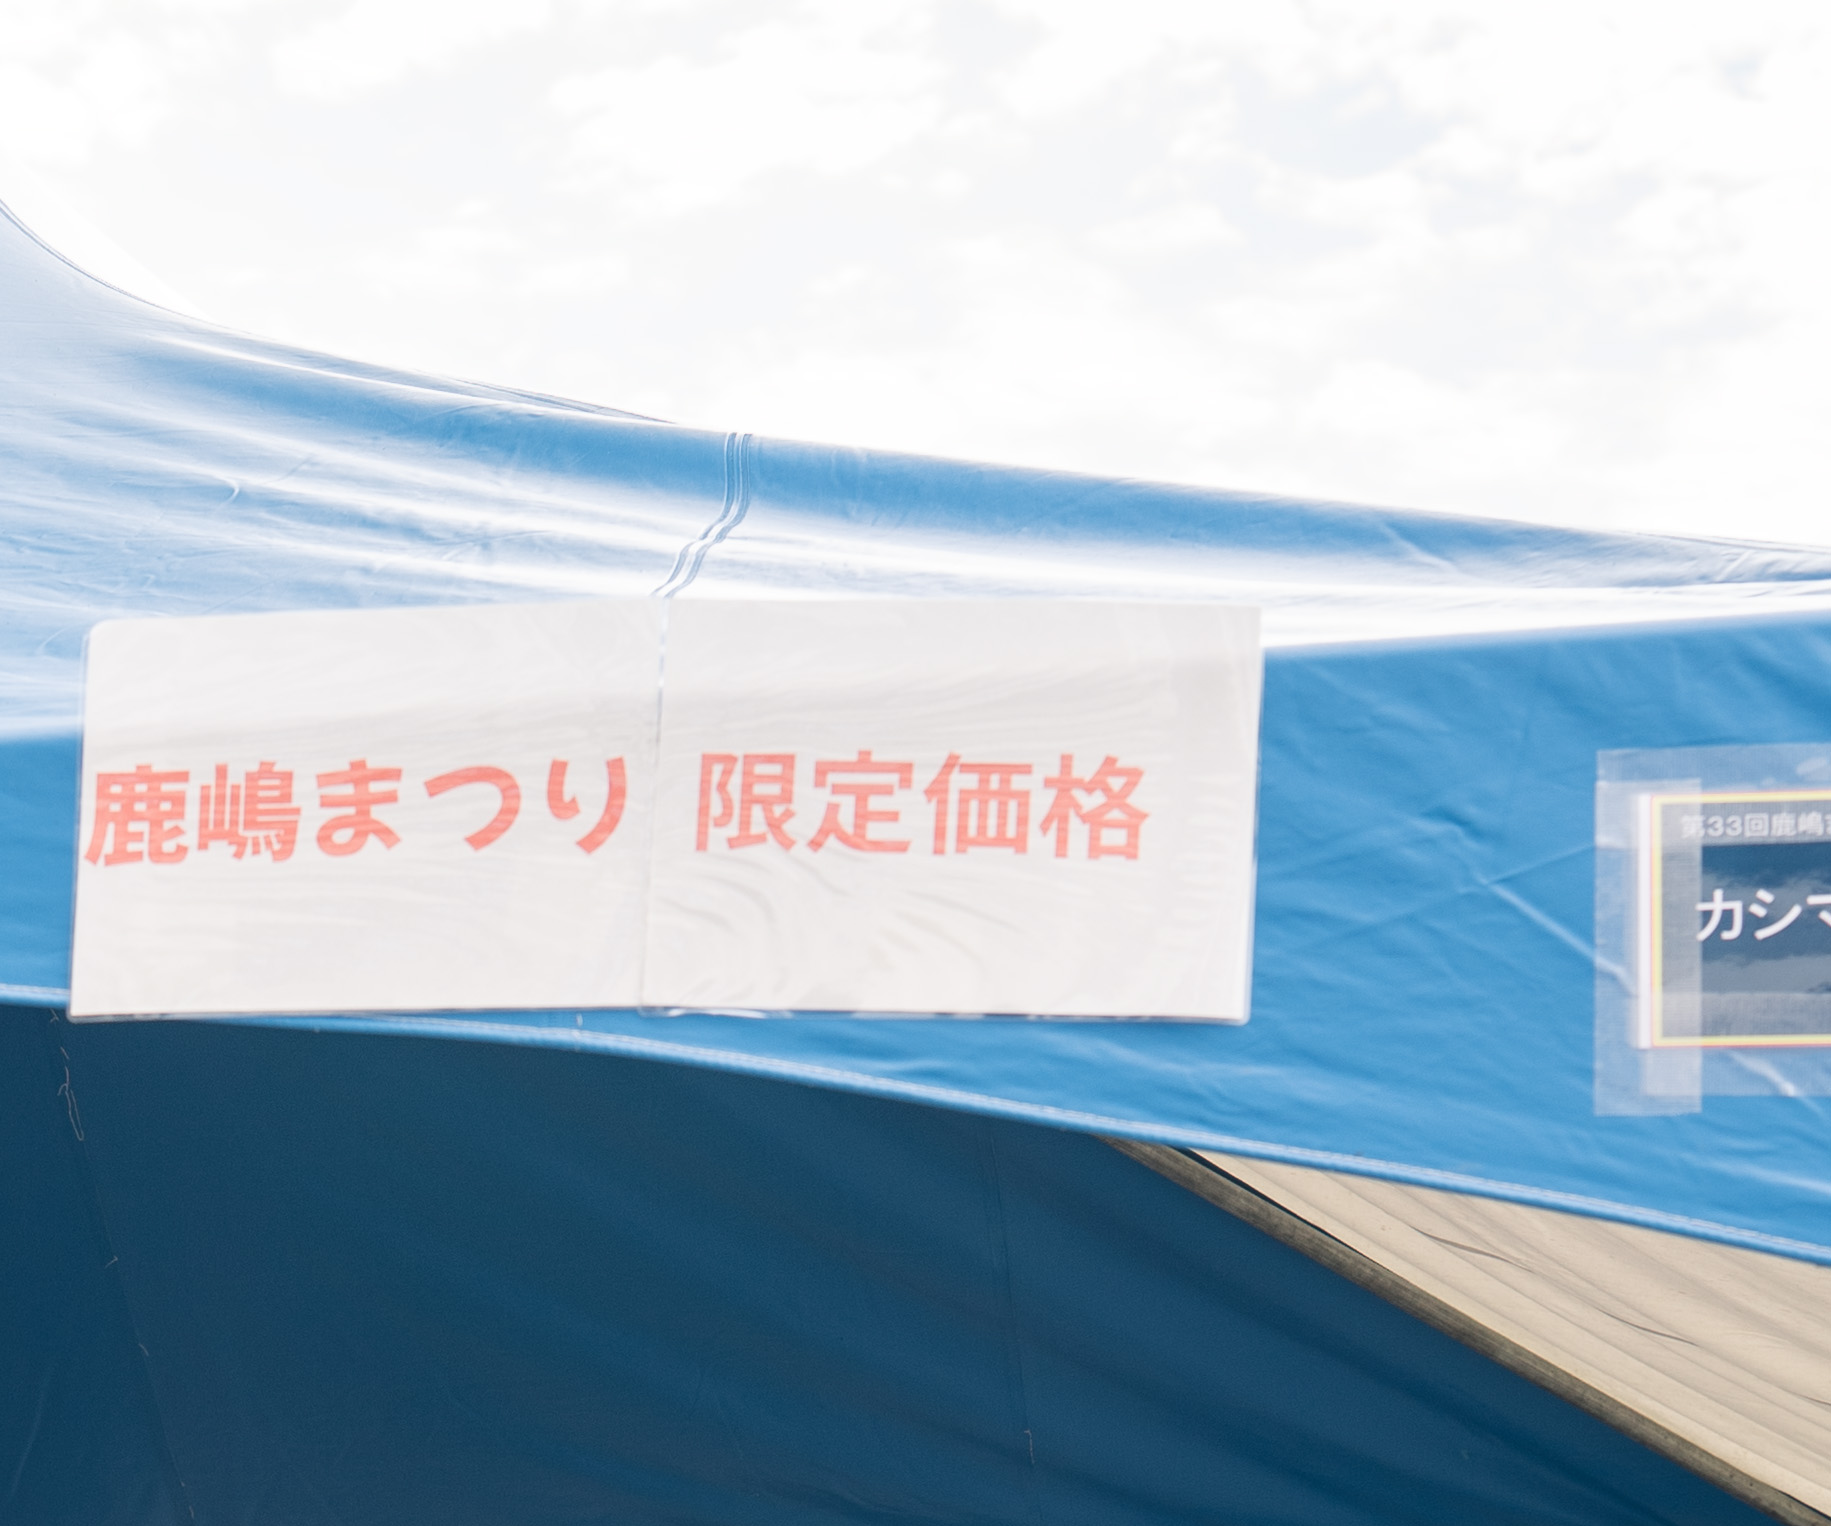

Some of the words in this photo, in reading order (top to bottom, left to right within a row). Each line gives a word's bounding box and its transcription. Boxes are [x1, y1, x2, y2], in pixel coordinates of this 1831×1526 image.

[84, 754, 631, 868] 鹿嶋まつり
[694, 750, 1150, 860] 限定価格
[1680, 812, 1831, 839] 第33回鹿嶋
